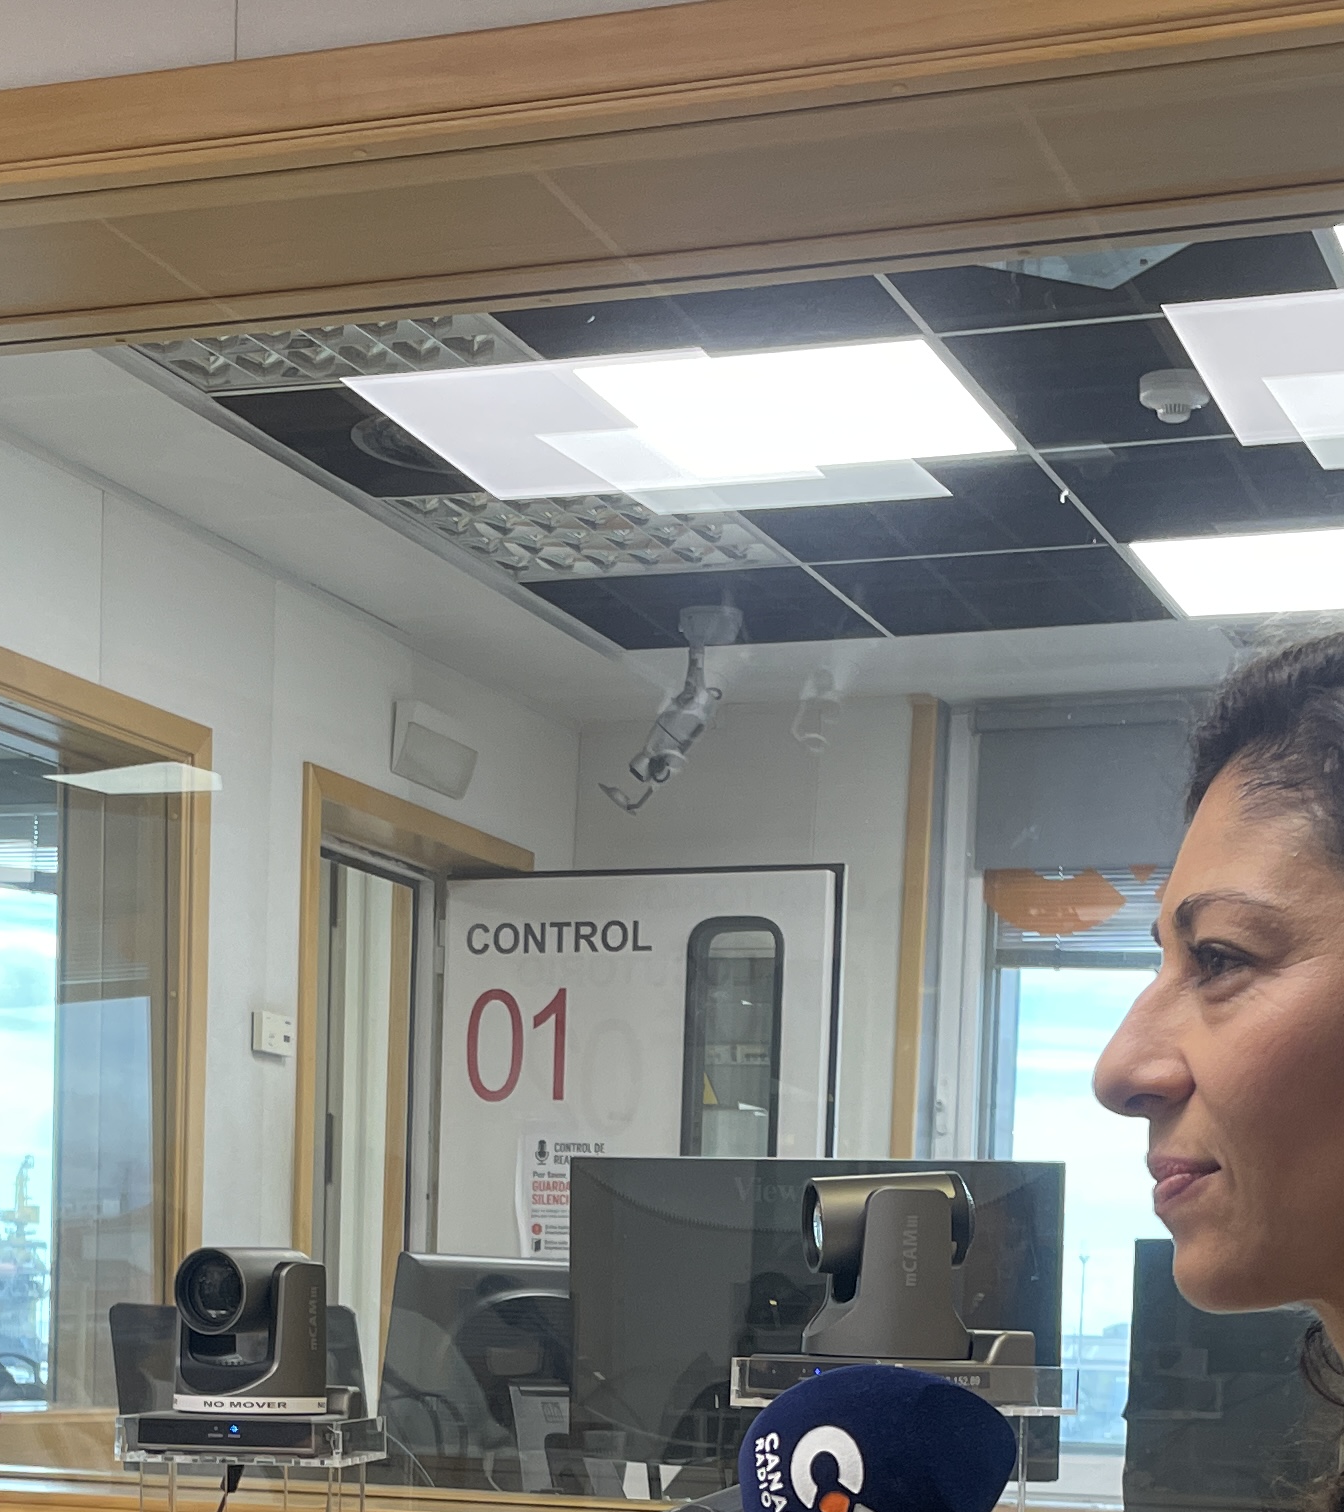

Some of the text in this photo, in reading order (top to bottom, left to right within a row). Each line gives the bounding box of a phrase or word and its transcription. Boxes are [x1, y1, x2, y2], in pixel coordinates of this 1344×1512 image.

[467, 920, 653, 955] CONTROL
[467, 987, 567, 1102] 01
[554, 1143, 605, 1153] CONTROL DE
[203, 1400, 224, 1408] NO
[229, 1401, 287, 1409] MOVER
[755, 1436, 772, 1508] RADIO
